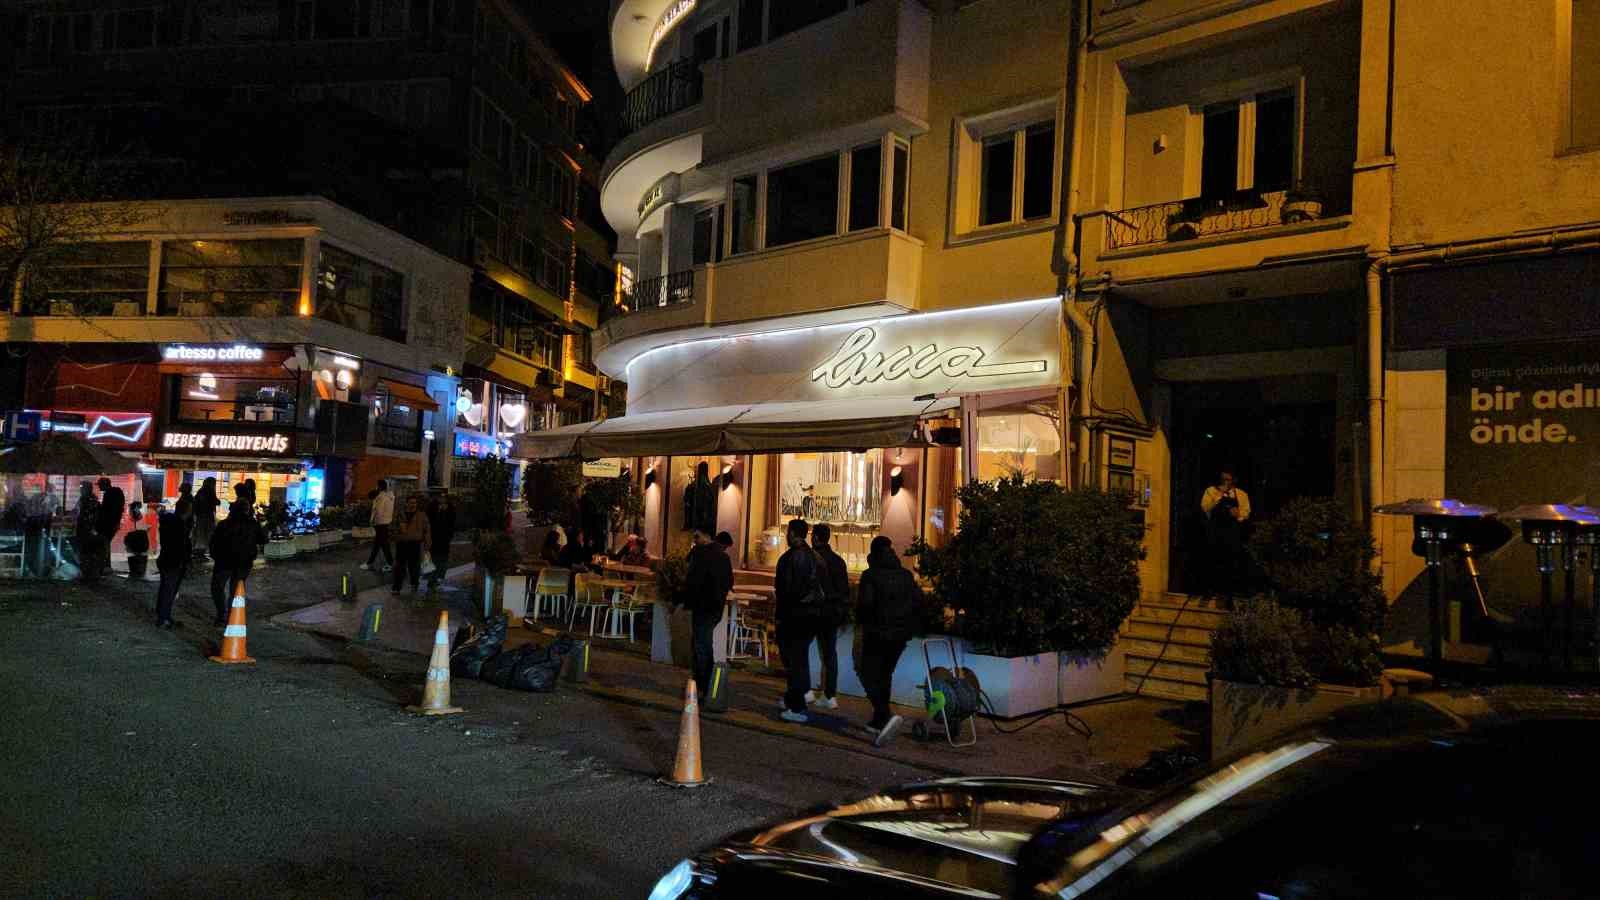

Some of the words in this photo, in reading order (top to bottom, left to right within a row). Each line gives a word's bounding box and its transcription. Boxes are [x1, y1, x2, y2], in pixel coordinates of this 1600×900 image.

[165, 346, 216, 360] artesso
[217, 345, 263, 361] coffee
[1471, 385, 1521, 411] bir
[1471, 418, 1577, 444] önde.
[163, 433, 205, 448] BEBEK
[209, 433, 289, 453] KURUYEMİŞ
